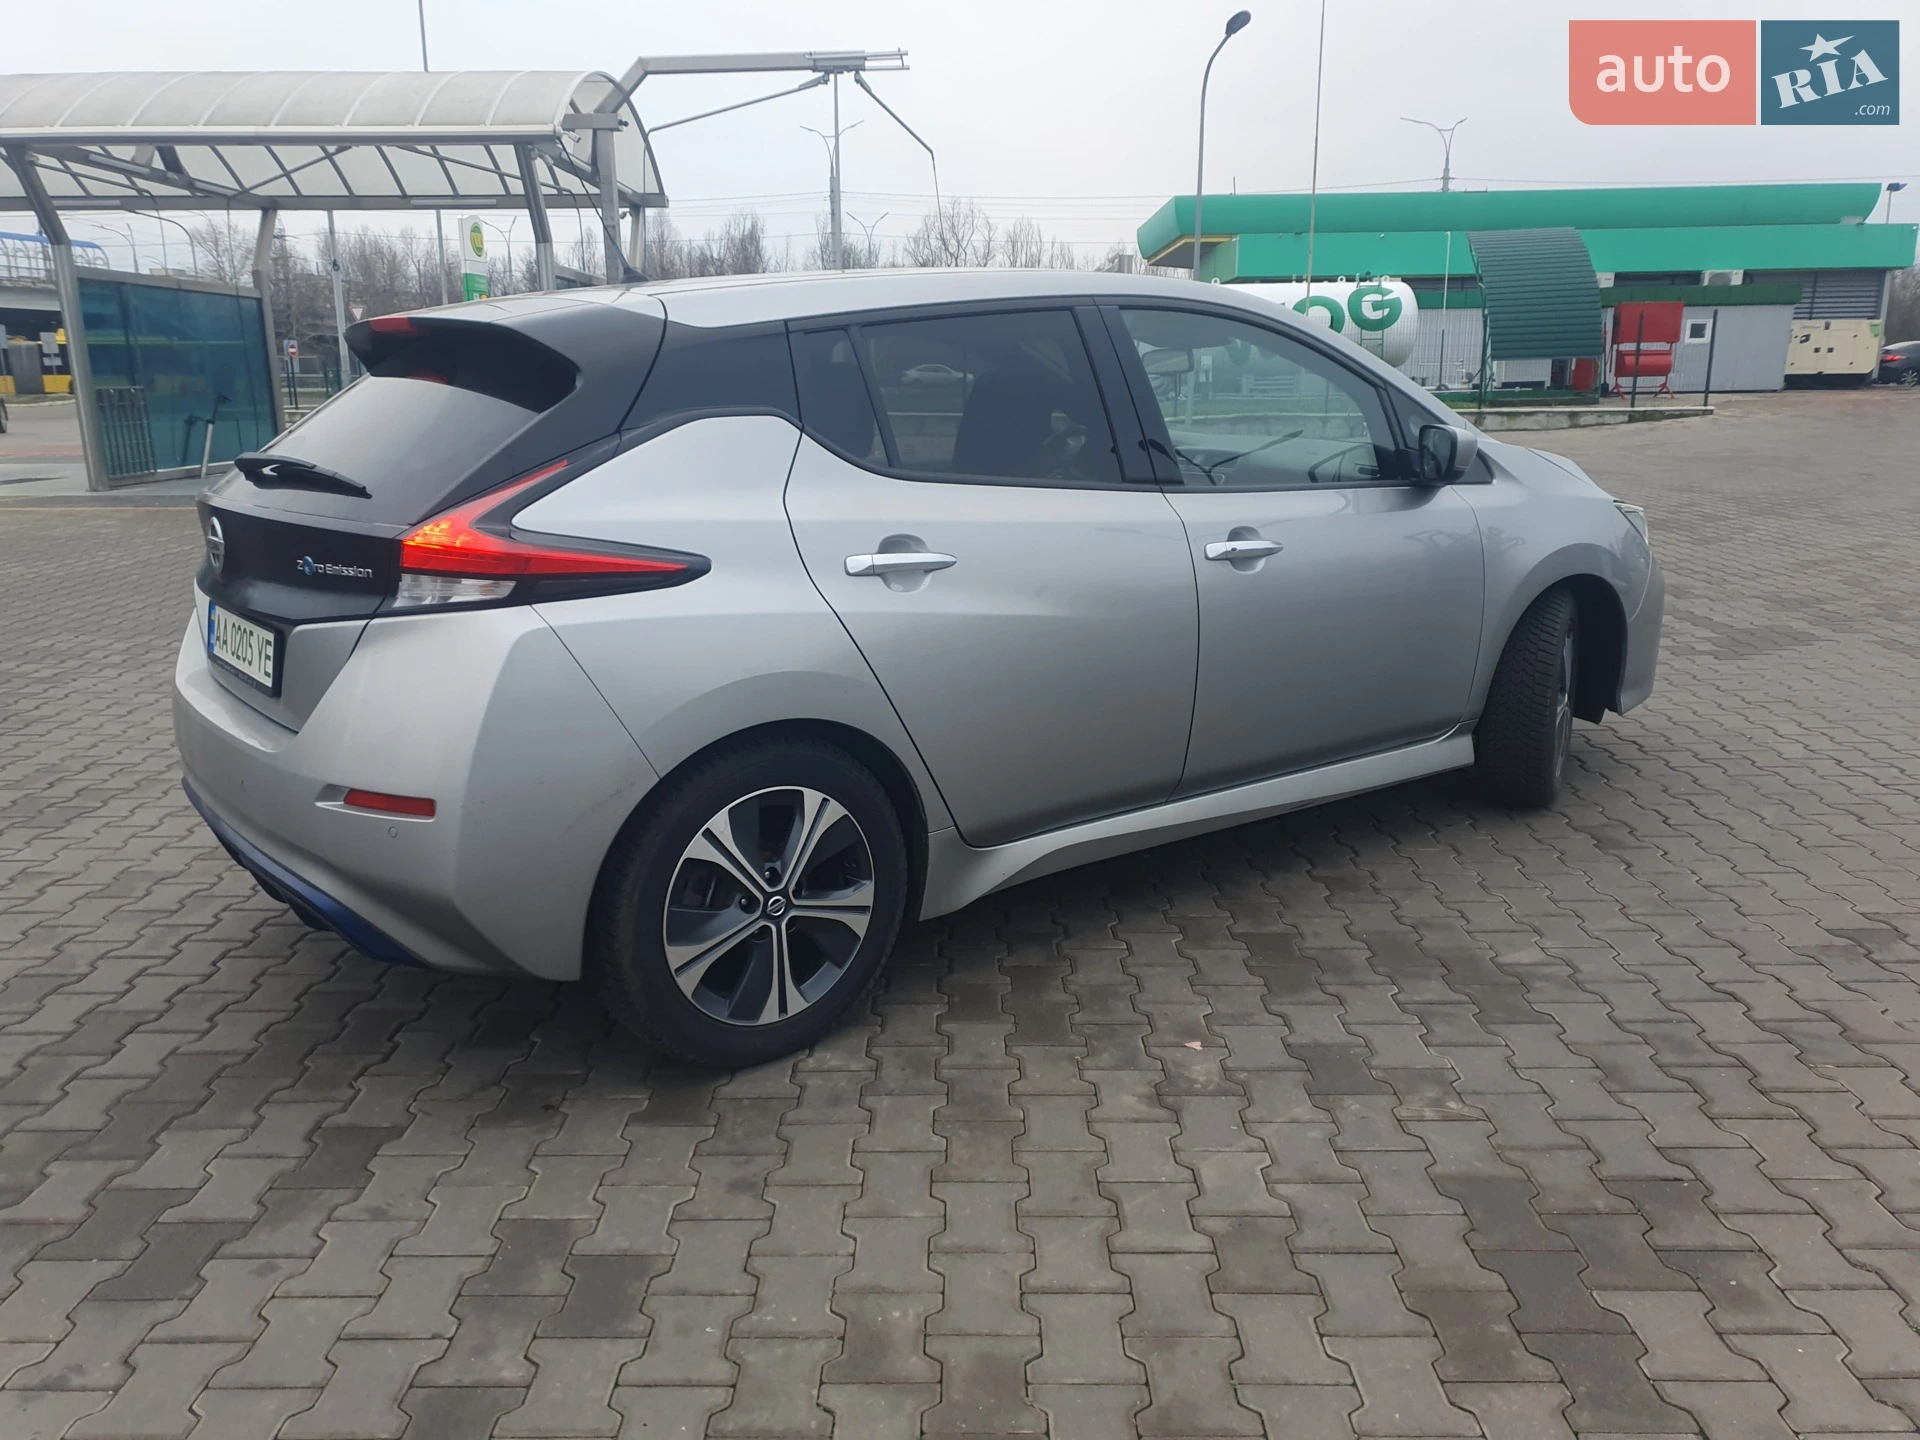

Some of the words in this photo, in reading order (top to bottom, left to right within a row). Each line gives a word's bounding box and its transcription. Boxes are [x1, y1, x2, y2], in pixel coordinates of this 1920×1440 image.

[1279, 286, 1403, 334] OG
[215, 613, 228, 654] AA
[230, 621, 254, 667] 0205
[256, 633, 272, 678] YE
